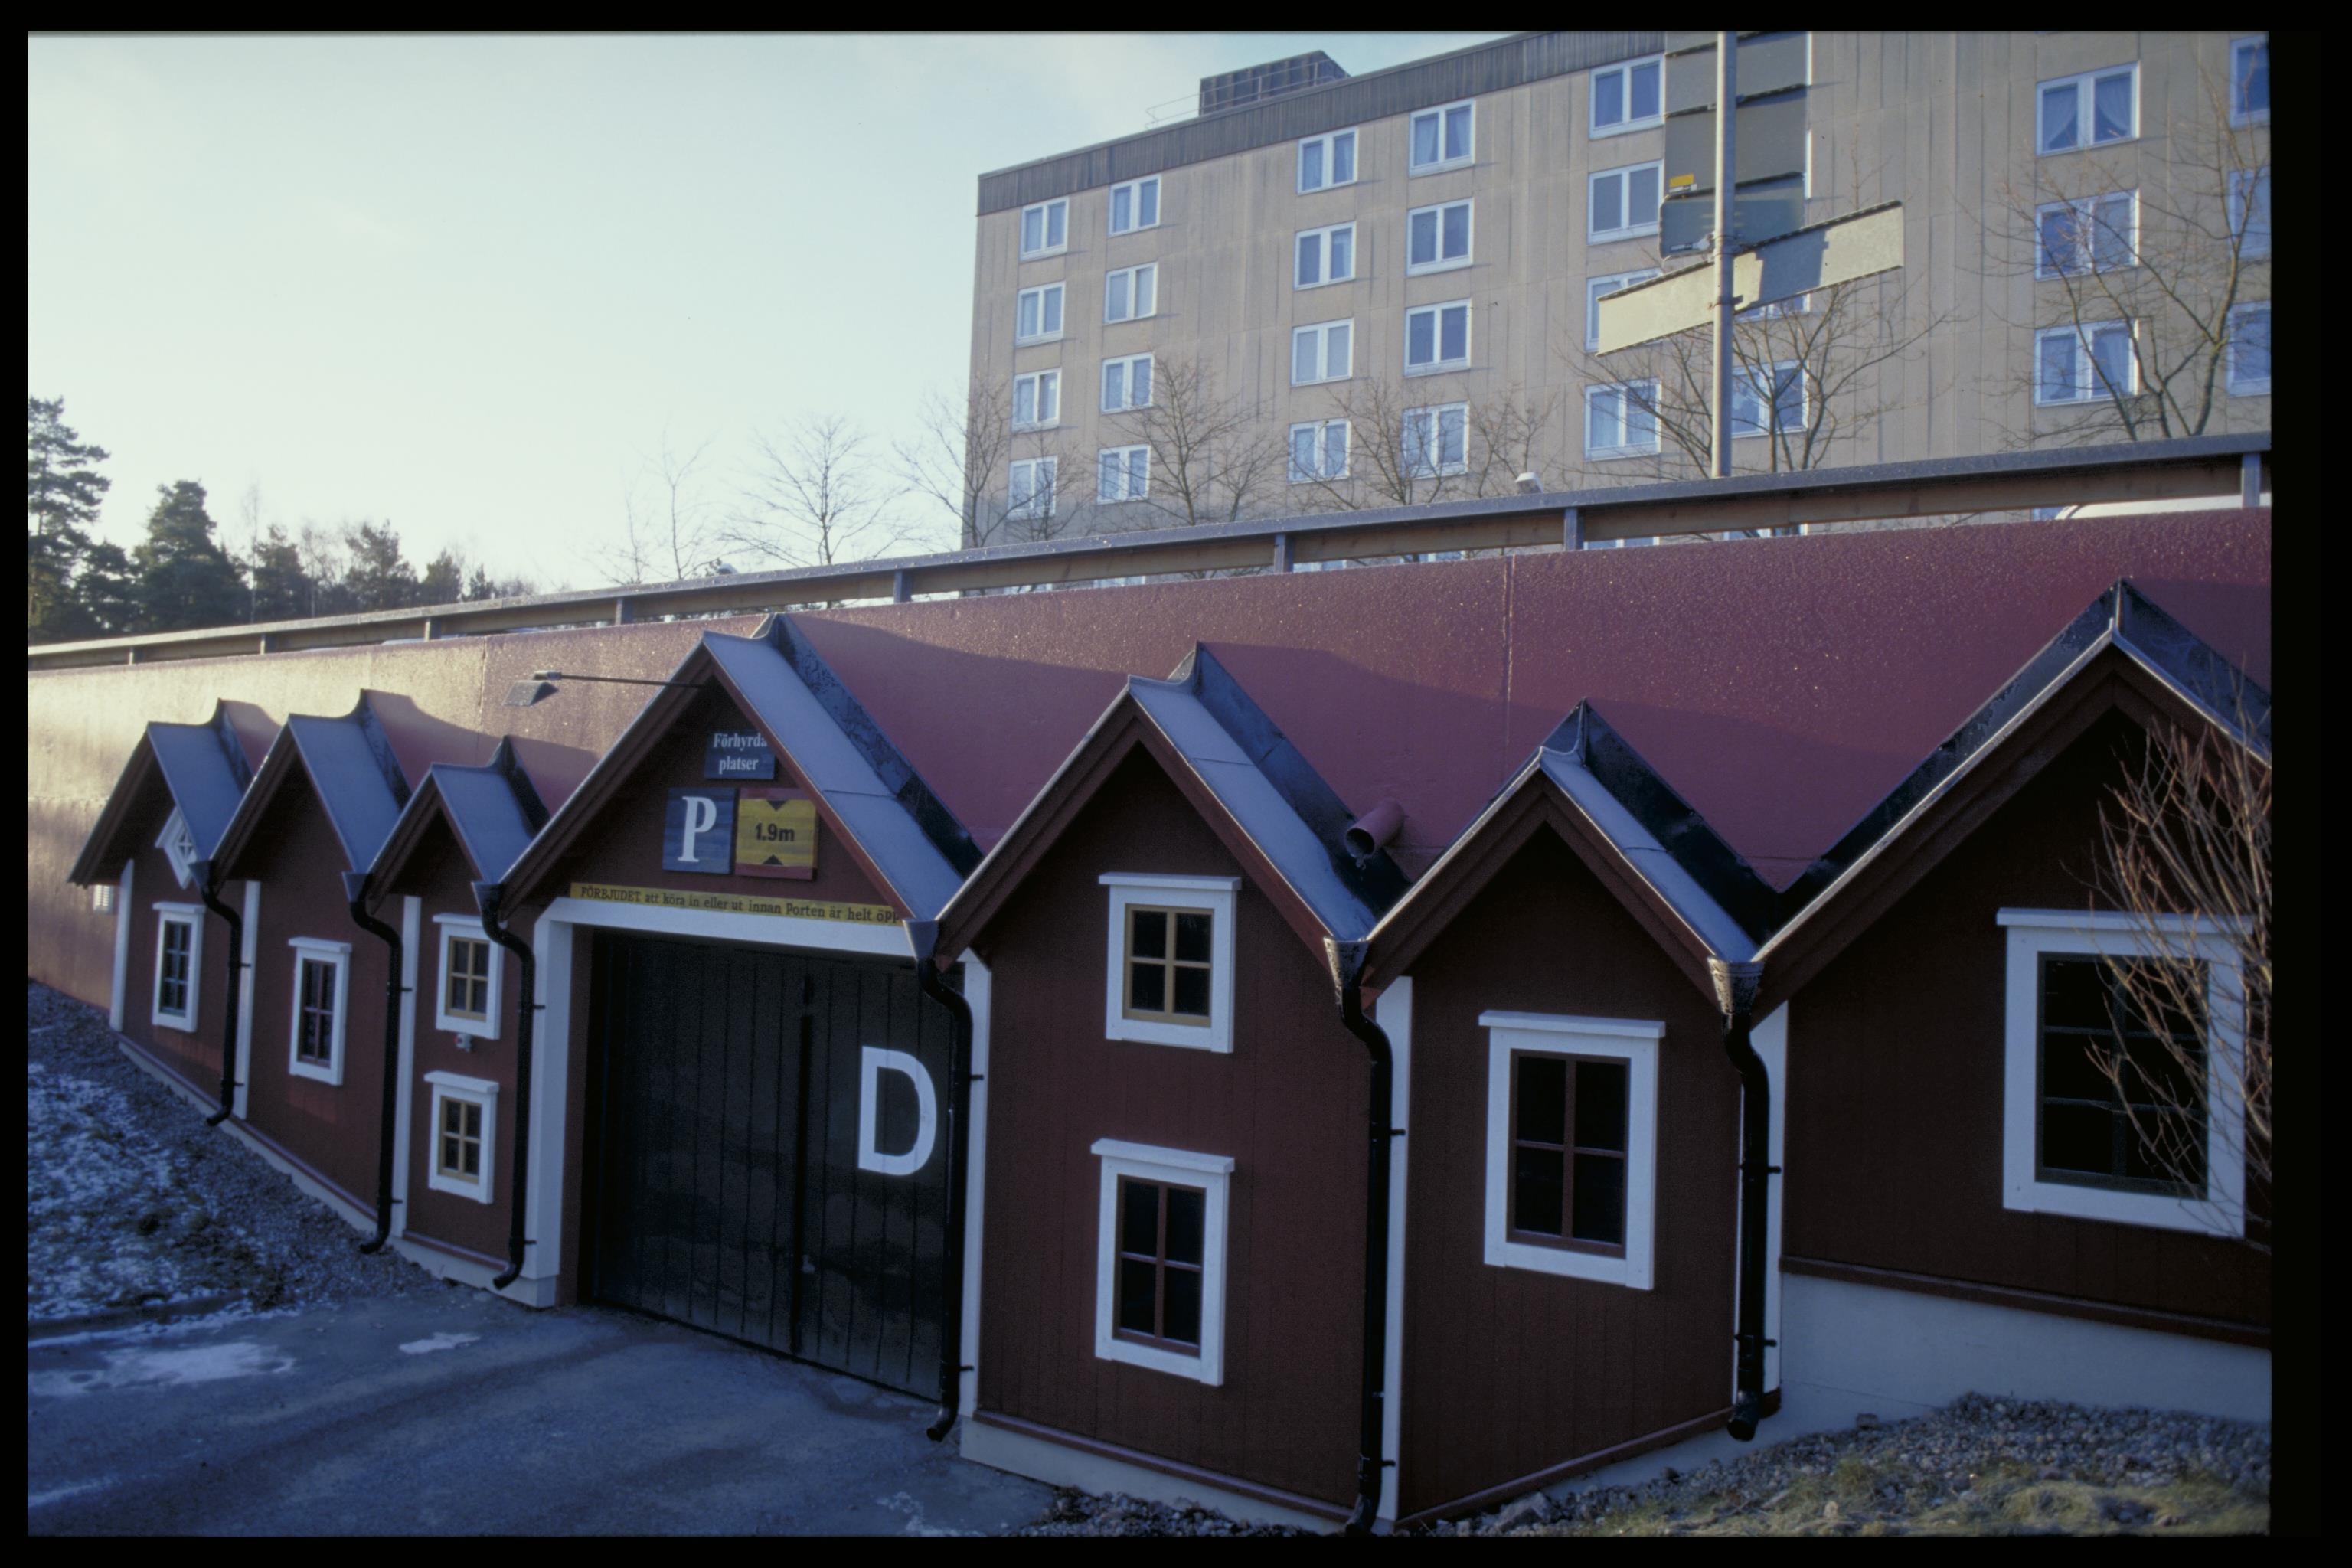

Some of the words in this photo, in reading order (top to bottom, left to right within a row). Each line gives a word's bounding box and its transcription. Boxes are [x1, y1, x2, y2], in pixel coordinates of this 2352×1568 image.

[713, 732, 768, 751] Förhyrda
[719, 756, 759, 775] platser
[678, 796, 717, 862] P
[756, 822, 795, 842] 1.9m
[581, 885, 641, 903] FÖRBJUDET
[645, 893, 658, 903] att
[663, 893, 686, 906] köra
[690, 895, 700, 907] in
[704, 897, 728, 910] eller
[732, 900, 743, 911] ut
[749, 900, 782, 914] innan
[786, 903, 825, 917] Porten
[829, 906, 842, 919] är
[848, 906, 873, 920] helt
[858, 1046, 937, 1176] D
